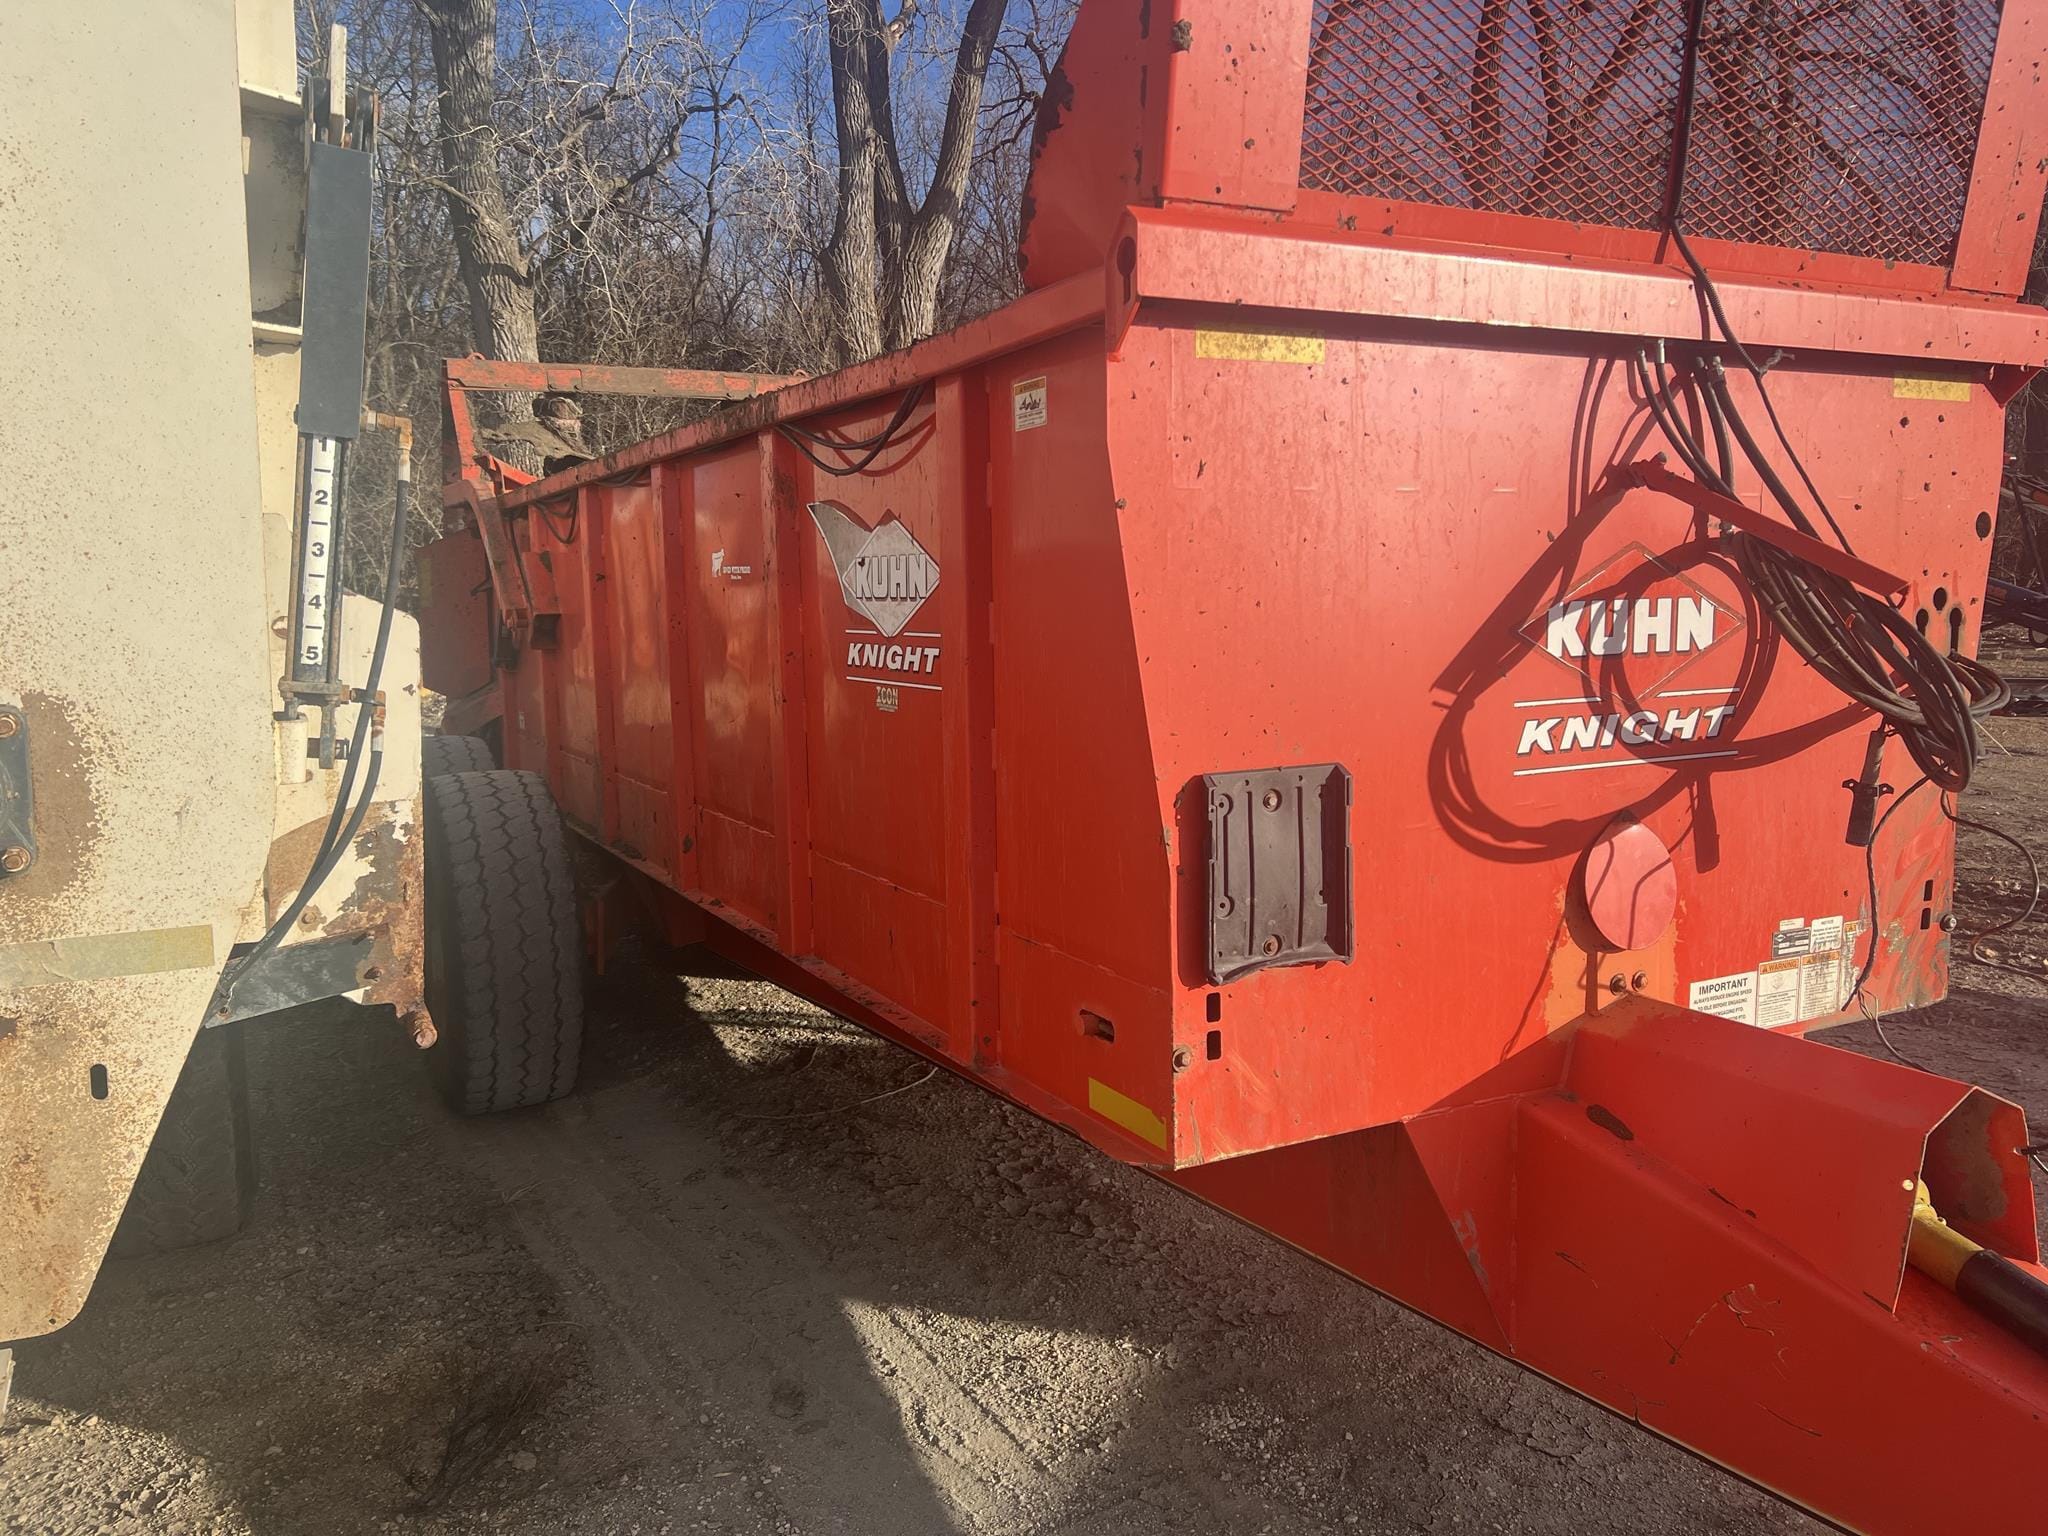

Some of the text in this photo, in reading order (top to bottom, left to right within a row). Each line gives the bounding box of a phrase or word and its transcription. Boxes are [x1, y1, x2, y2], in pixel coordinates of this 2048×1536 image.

[314, 489, 328, 505] 2
[311, 542, 325, 557] 3
[856, 553, 927, 600] KUHN
[308, 594, 322, 609] 4
[1546, 597, 1716, 659] KUHN
[305, 645, 319, 660] 5
[847, 642, 940, 674] KNIGHT
[875, 686, 899, 706] ICON
[1516, 704, 1736, 755] KNIGHT
[1768, 961, 1797, 971] WARNING
[1699, 977, 1748, 995] IMPORTANT
[1713, 1001, 1728, 1009] BEFORE
